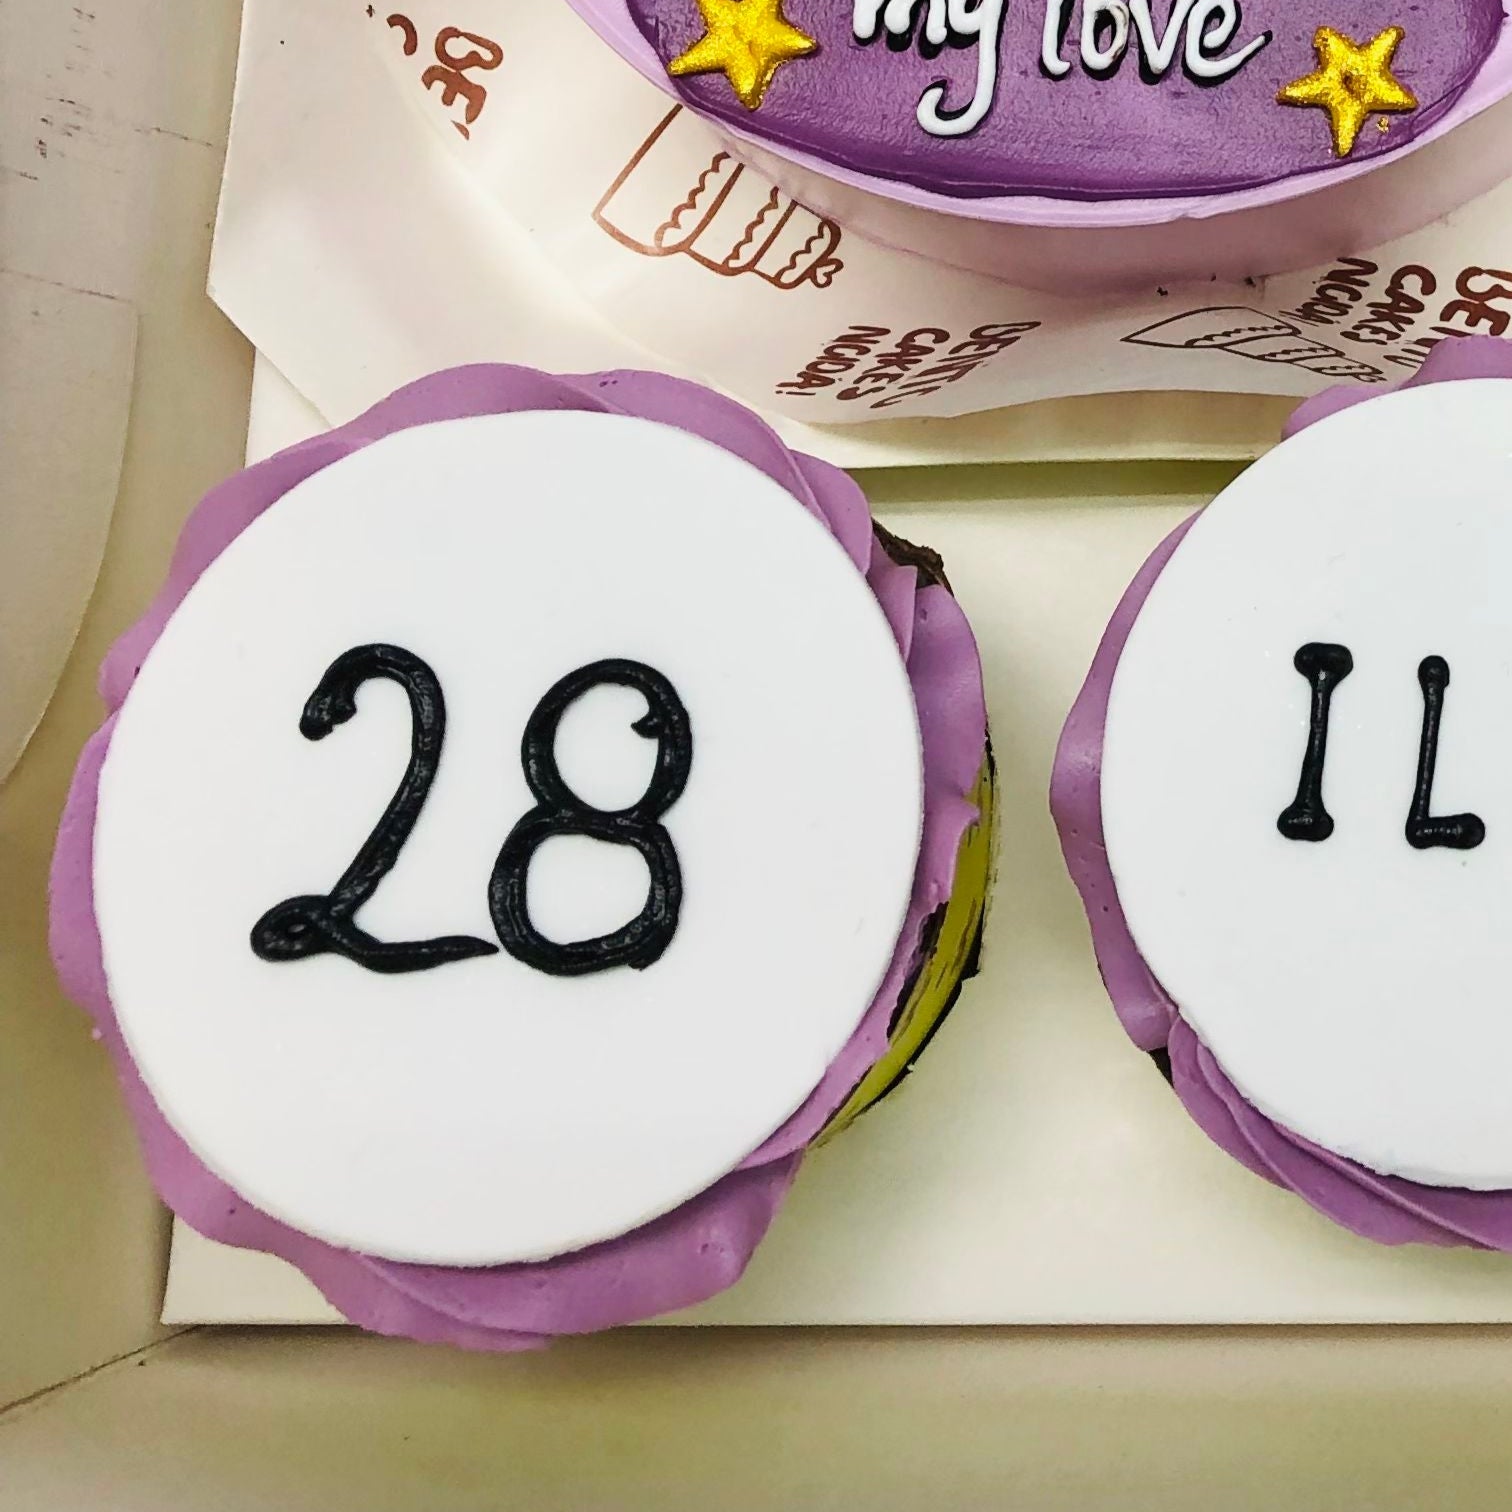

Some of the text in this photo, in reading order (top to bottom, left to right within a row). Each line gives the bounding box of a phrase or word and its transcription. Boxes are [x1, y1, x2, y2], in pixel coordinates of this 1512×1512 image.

[1339, 264, 1438, 346] CAKES
[835, 327, 951, 401] CAKES
[250, 642, 694, 978] 28
